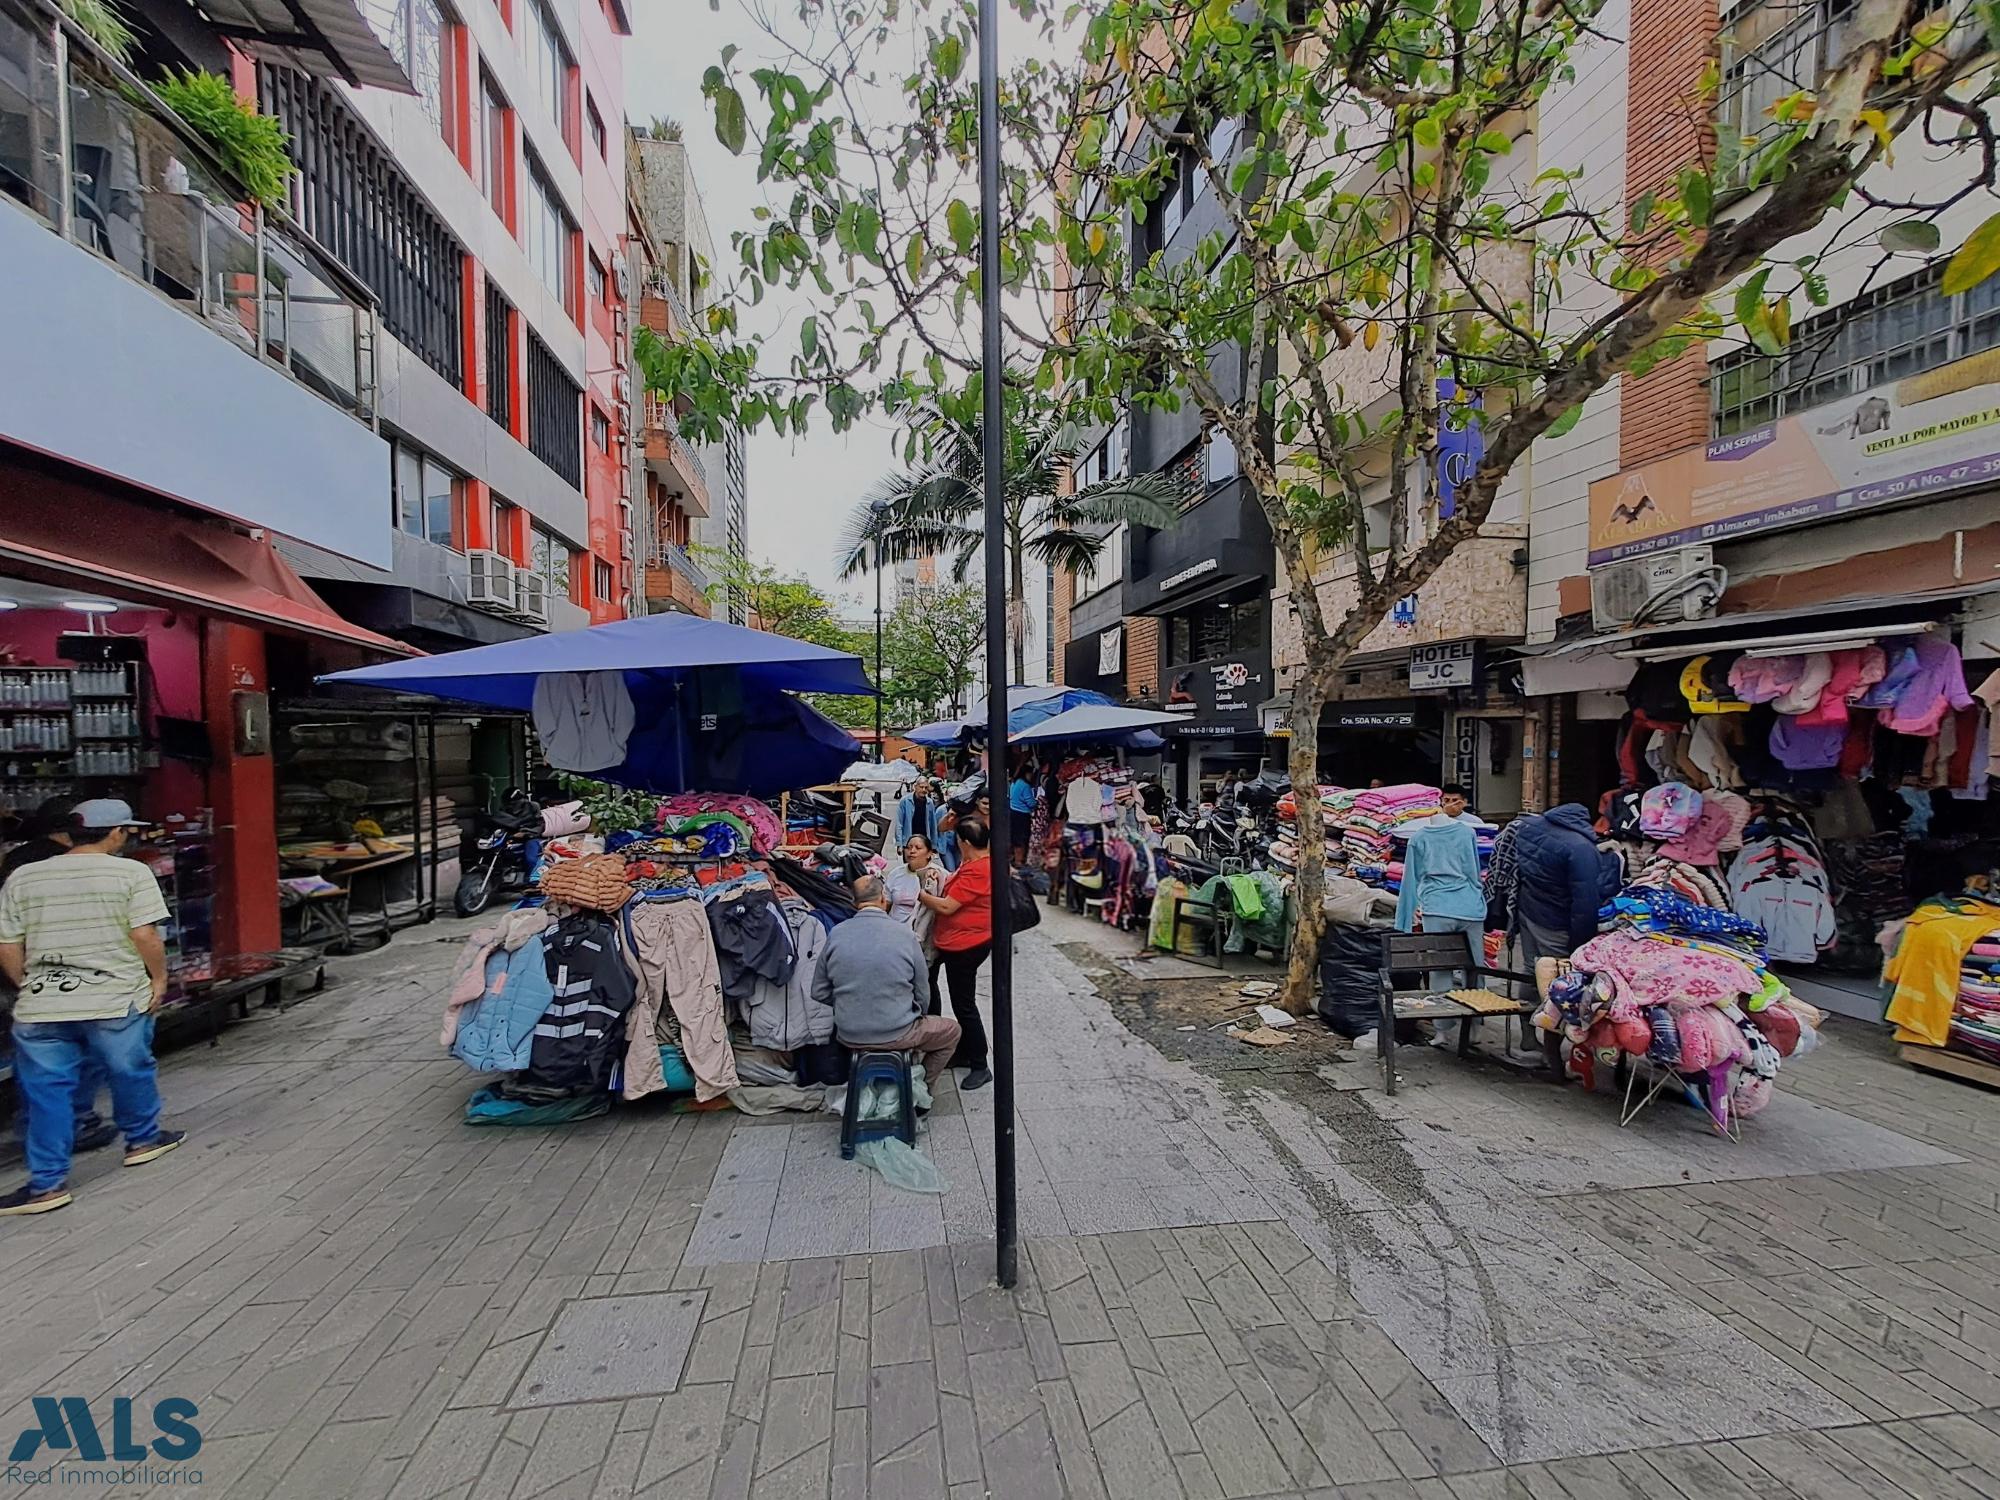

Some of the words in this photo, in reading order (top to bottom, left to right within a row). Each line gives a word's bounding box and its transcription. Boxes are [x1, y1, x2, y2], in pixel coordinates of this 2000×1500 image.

[1708, 443, 1733, 458] PLAN
[1734, 429, 1771, 449] SEPARE
[1866, 436, 1896, 454] VENTA
[1897, 430, 1909, 445] AL
[1913, 421, 1937, 441] POR
[1939, 412, 1979, 435] MAYOR
[1980, 408, 1990, 422] Y
[1858, 488, 1885, 501] Cra.
[1887, 482, 1905, 496] 50
[1906, 481, 1918, 490] A
[1921, 472, 1946, 487] No.
[1949, 465, 1970, 480] 47
[1981, 460, 2000, 474] 39
[1716, 517, 1760, 534] Almacen
[1764, 503, 1818, 522] Imbabura
[1412, 642, 1473, 663] HOTEL
[1427, 663, 1454, 679] JC
[1355, 716, 1370, 724] 50A
[1371, 716, 1382, 724] No.
[1400, 715, 1411, 723] 29
[1460, 719, 1473, 789] HOTE
